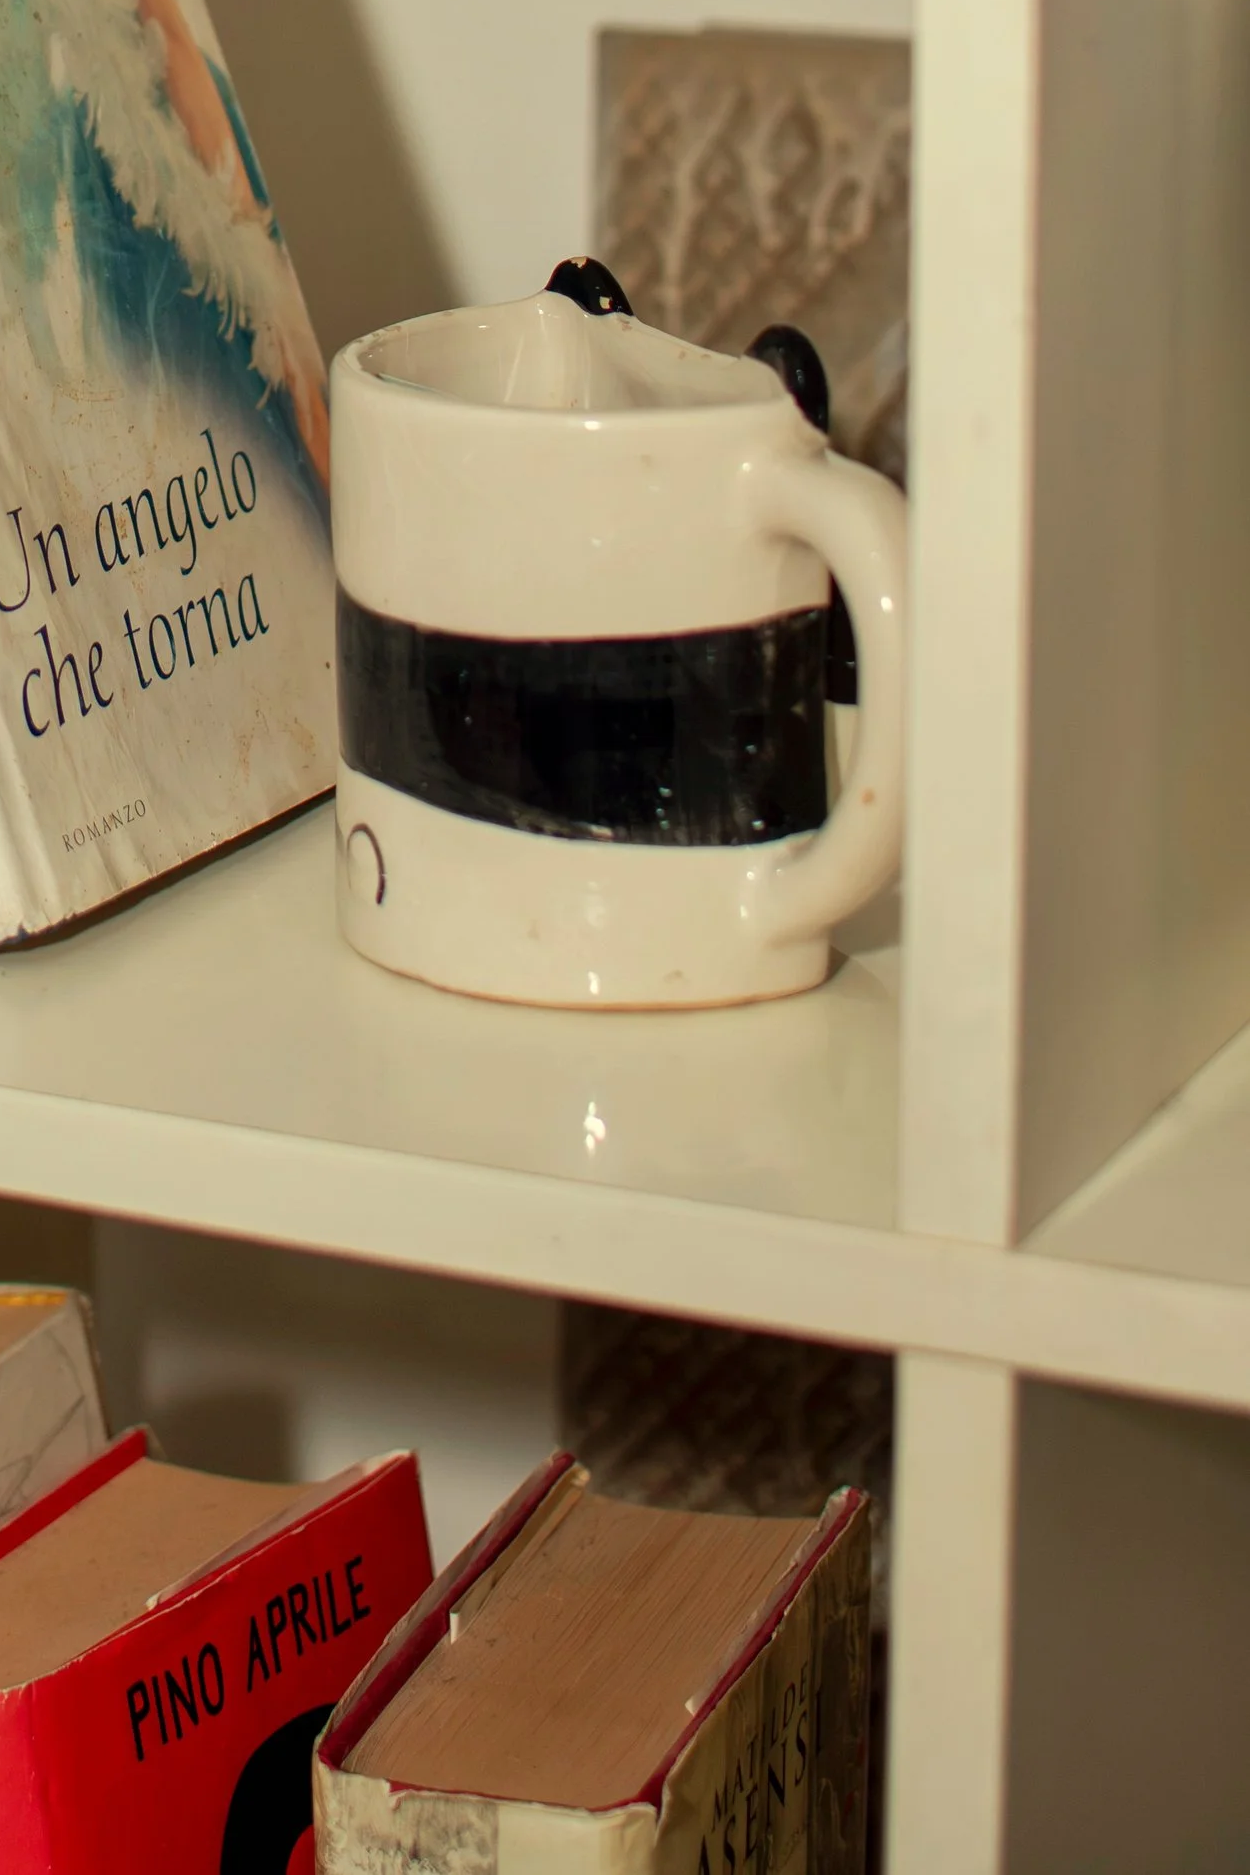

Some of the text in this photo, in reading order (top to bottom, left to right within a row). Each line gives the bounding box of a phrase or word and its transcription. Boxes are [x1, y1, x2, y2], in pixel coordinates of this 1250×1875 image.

[94, 427, 259, 576] angelo
[20, 571, 270, 739] che torna
[61, 797, 148, 854] ROMANZO
[124, 1555, 372, 1763] PINO APRILE
